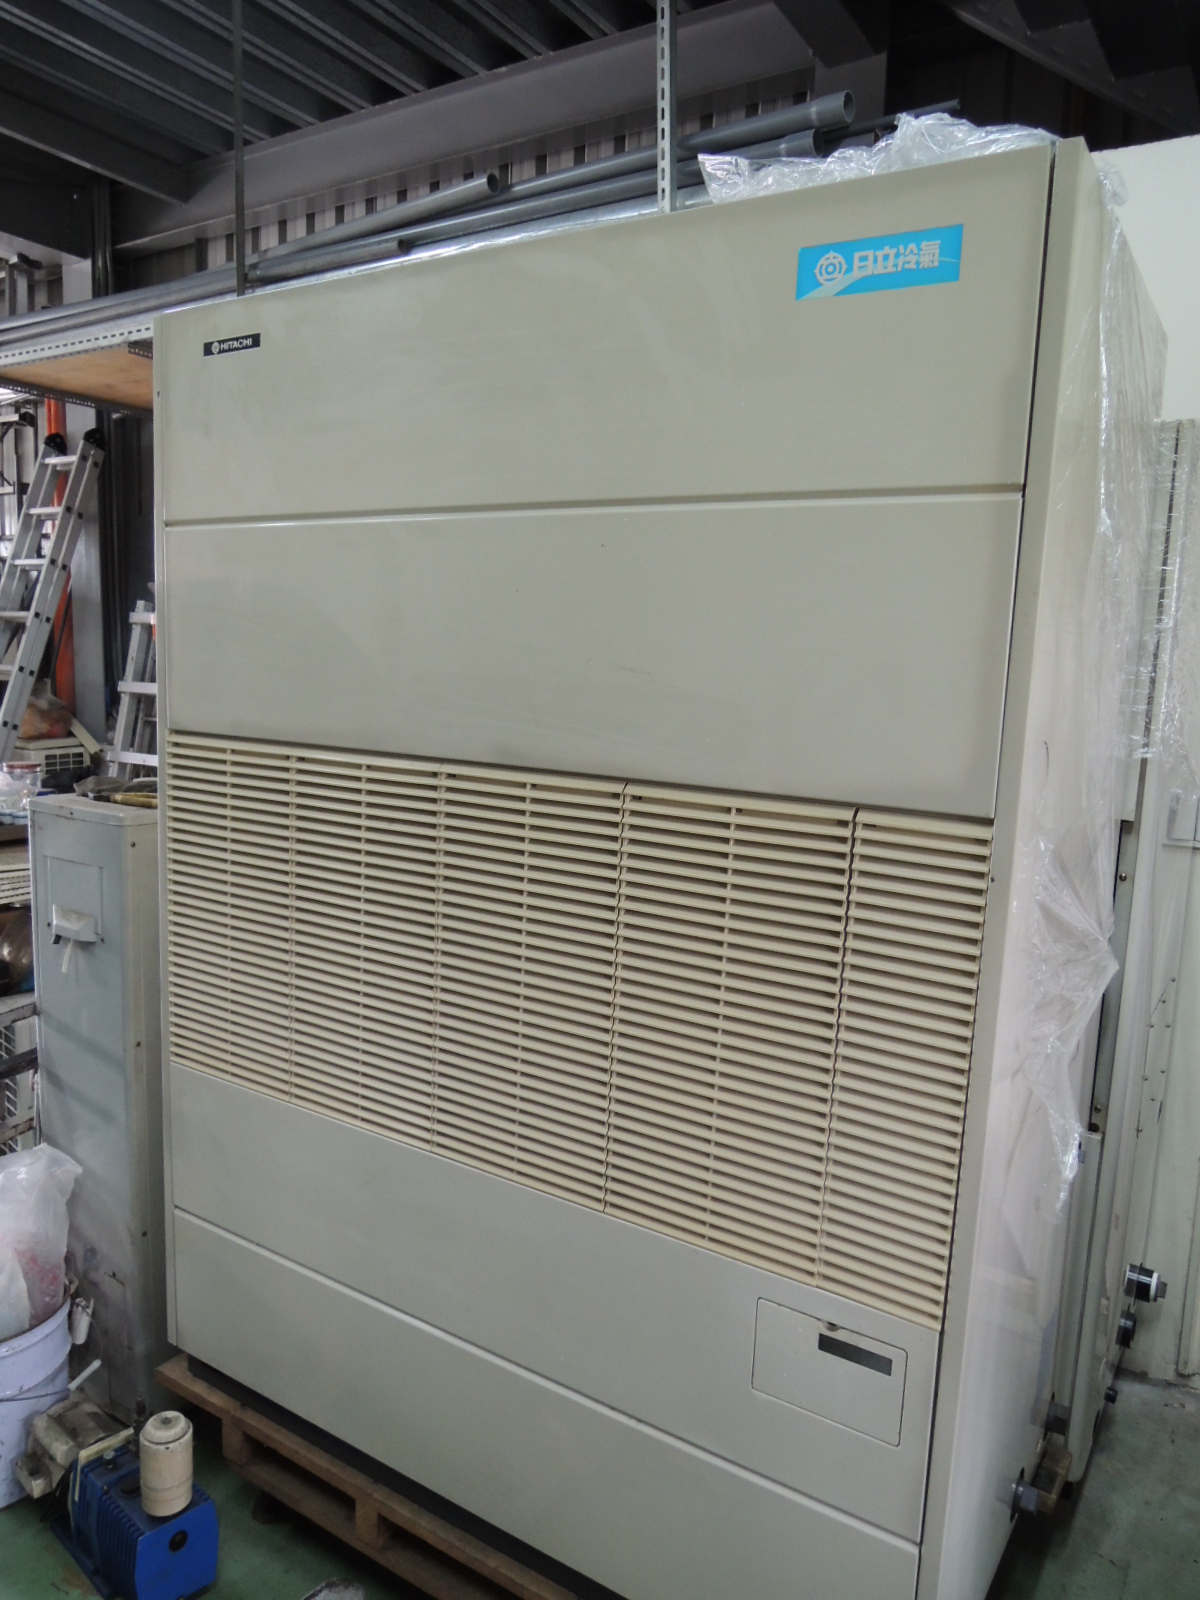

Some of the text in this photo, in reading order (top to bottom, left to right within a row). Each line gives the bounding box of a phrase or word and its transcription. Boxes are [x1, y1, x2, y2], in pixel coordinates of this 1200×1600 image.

[852, 240, 941, 276] 日立冷氣
[220, 338, 252, 350] HITACHI
